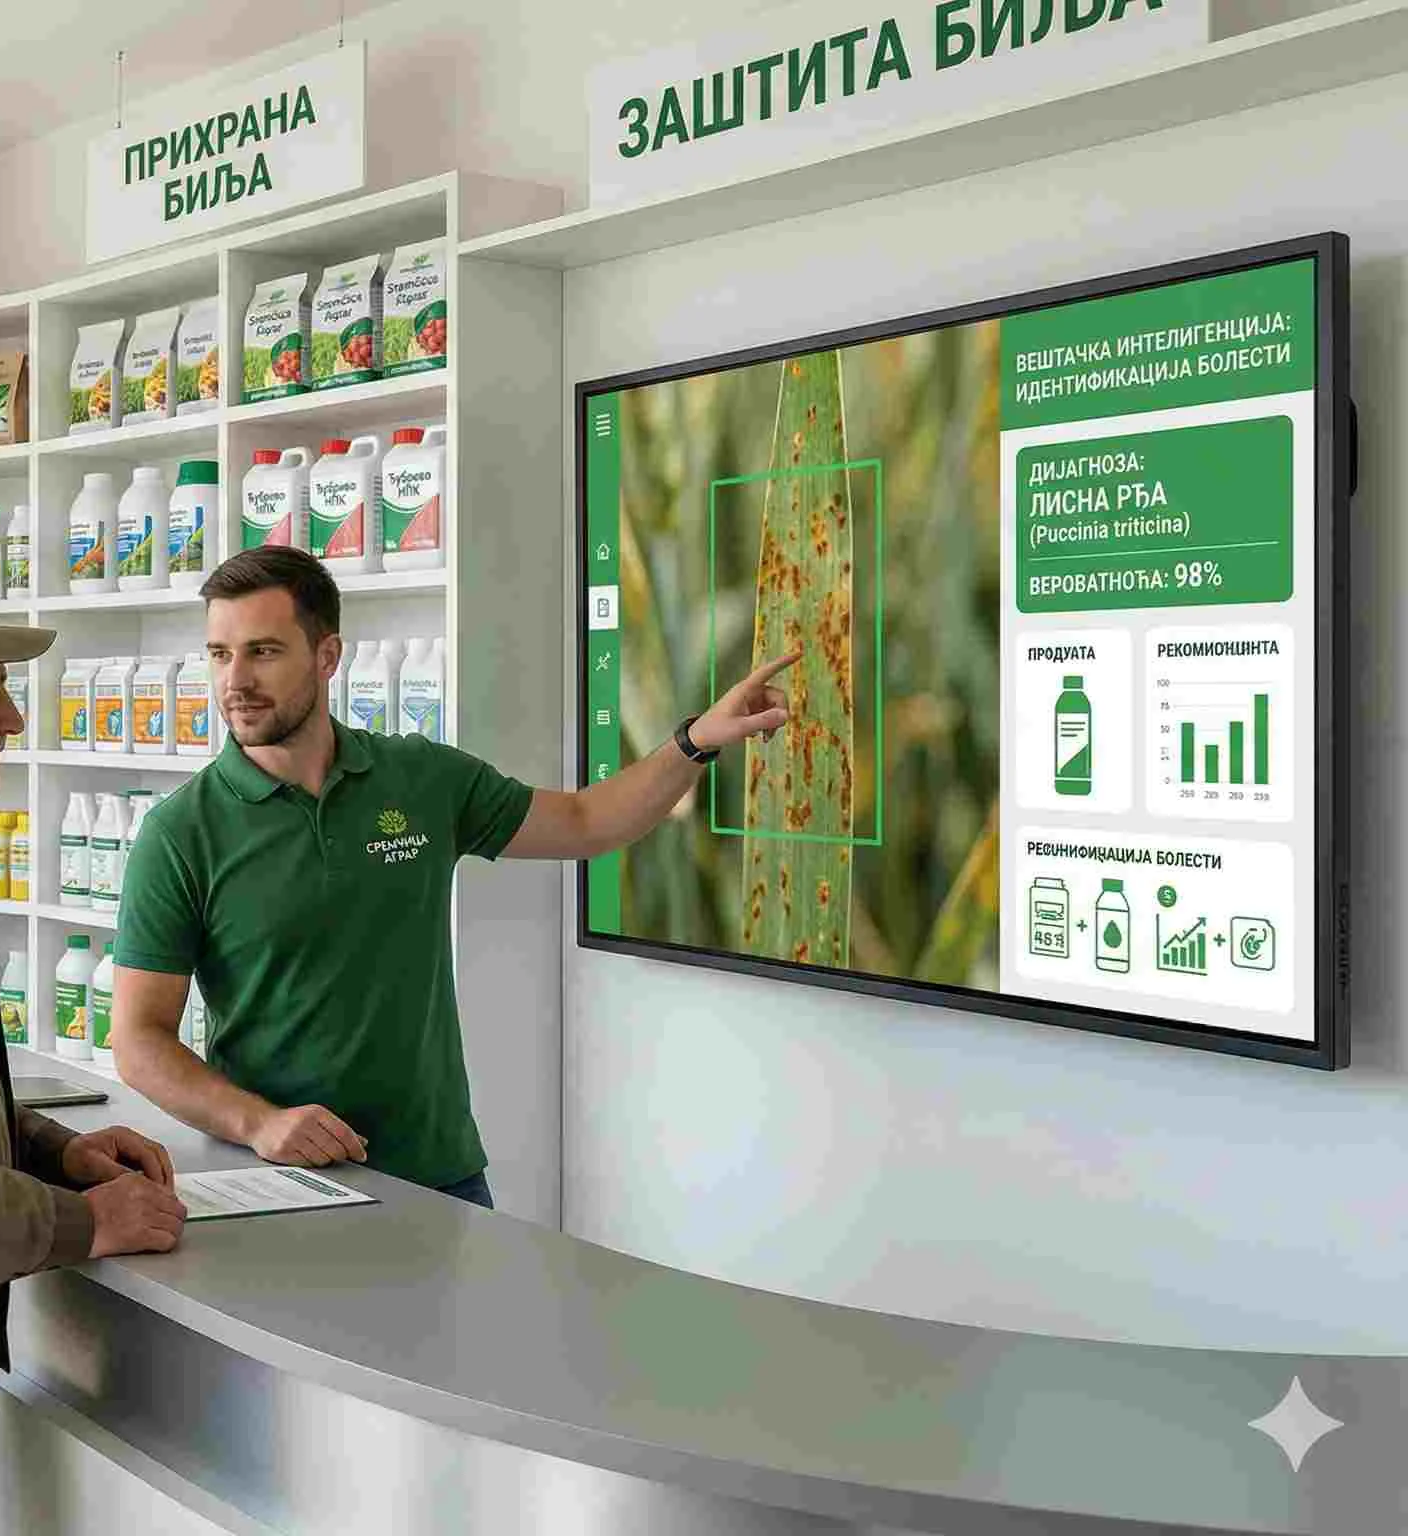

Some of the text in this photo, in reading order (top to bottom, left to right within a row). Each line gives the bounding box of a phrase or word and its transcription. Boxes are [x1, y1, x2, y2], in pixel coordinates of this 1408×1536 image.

[618, 18, 912, 158] ЗАШТИТА
[124, 85, 317, 185] ПРИХРАНА
[164, 152, 273, 222] БИЉА
[1016, 311, 1292, 373] ВЕШТАЧКА ИНТЕЛИГЕНЦИЈА:
[1016, 343, 1291, 404] ИДЕНТИФИКАЦИЈА БОЛЕСТИ
[1029, 452, 1145, 487] ДИЈАГНОЗА:
[1029, 481, 1168, 518] ЛИСНА РЂА
[1030, 511, 1191, 549] (Puccinia triticina)
[1029, 561, 1222, 596] ВЕРОВАТНОЋА: 98%
[1028, 646, 1096, 663] ПРОДУАТА
[1156, 850, 1222, 870] БОЛЕСТИ
